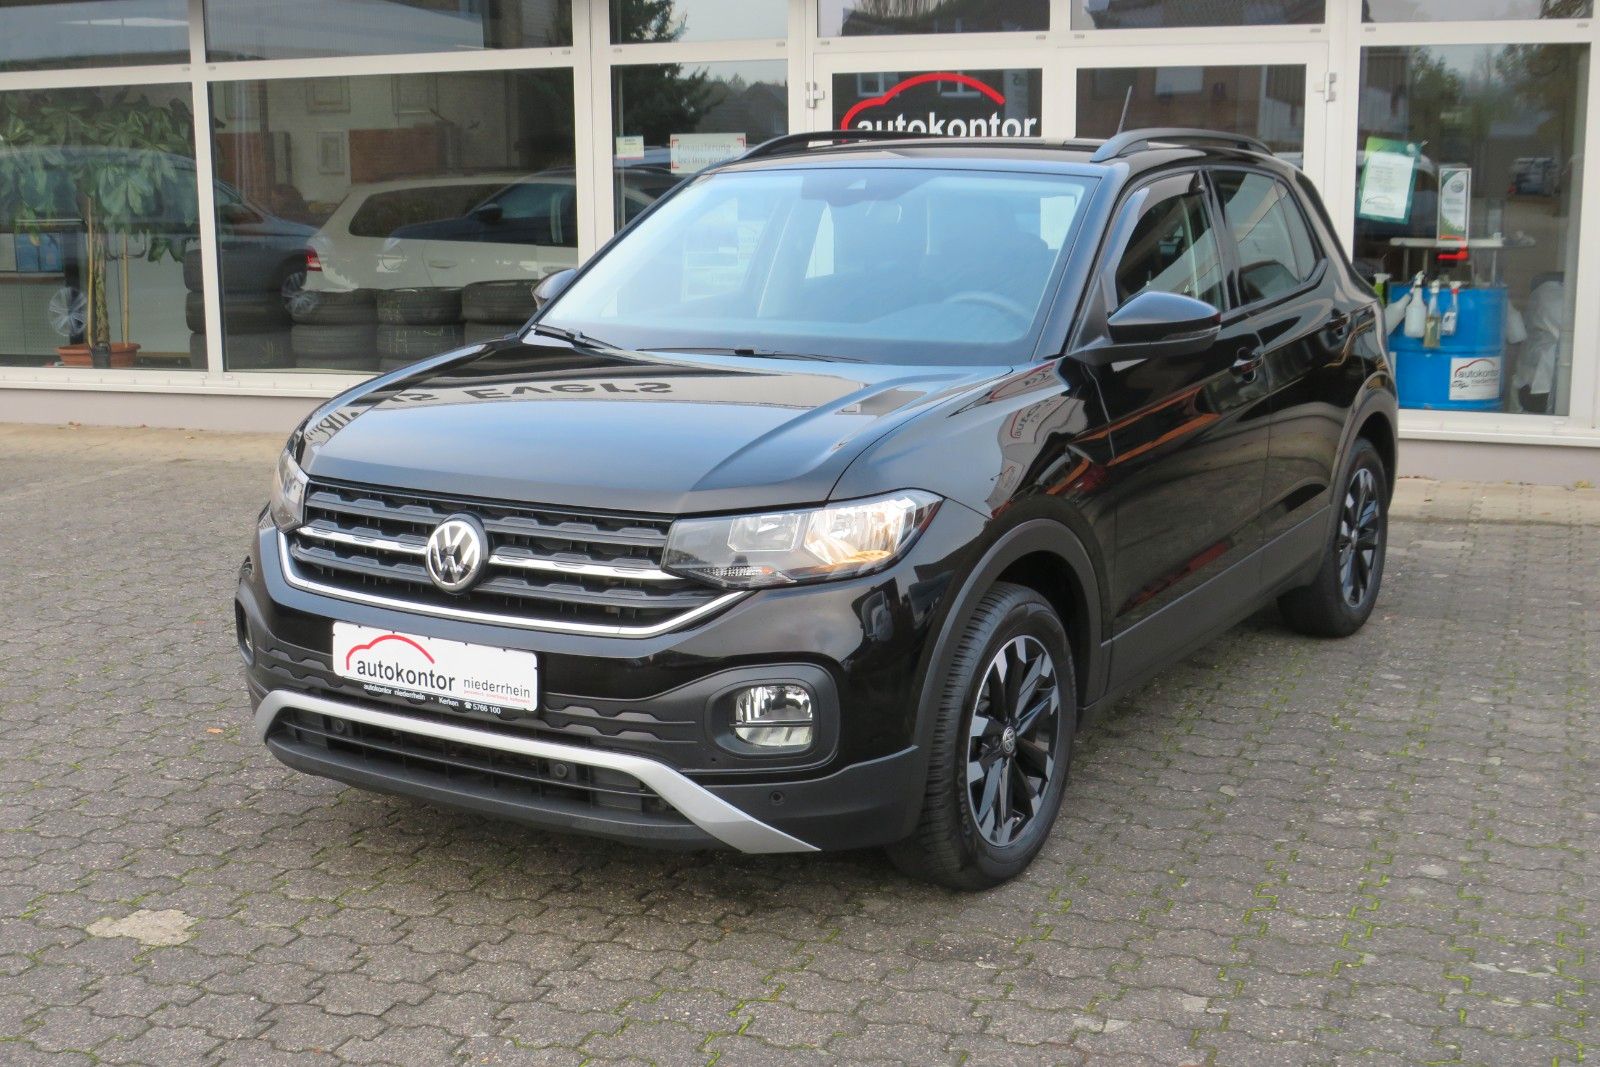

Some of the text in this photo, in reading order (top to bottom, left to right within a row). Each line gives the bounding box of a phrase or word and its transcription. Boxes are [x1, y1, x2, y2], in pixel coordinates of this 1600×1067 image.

[356, 659, 455, 692] autokontor
[463, 676, 531, 699] niederrhein
[490, 705, 501, 715] 100
